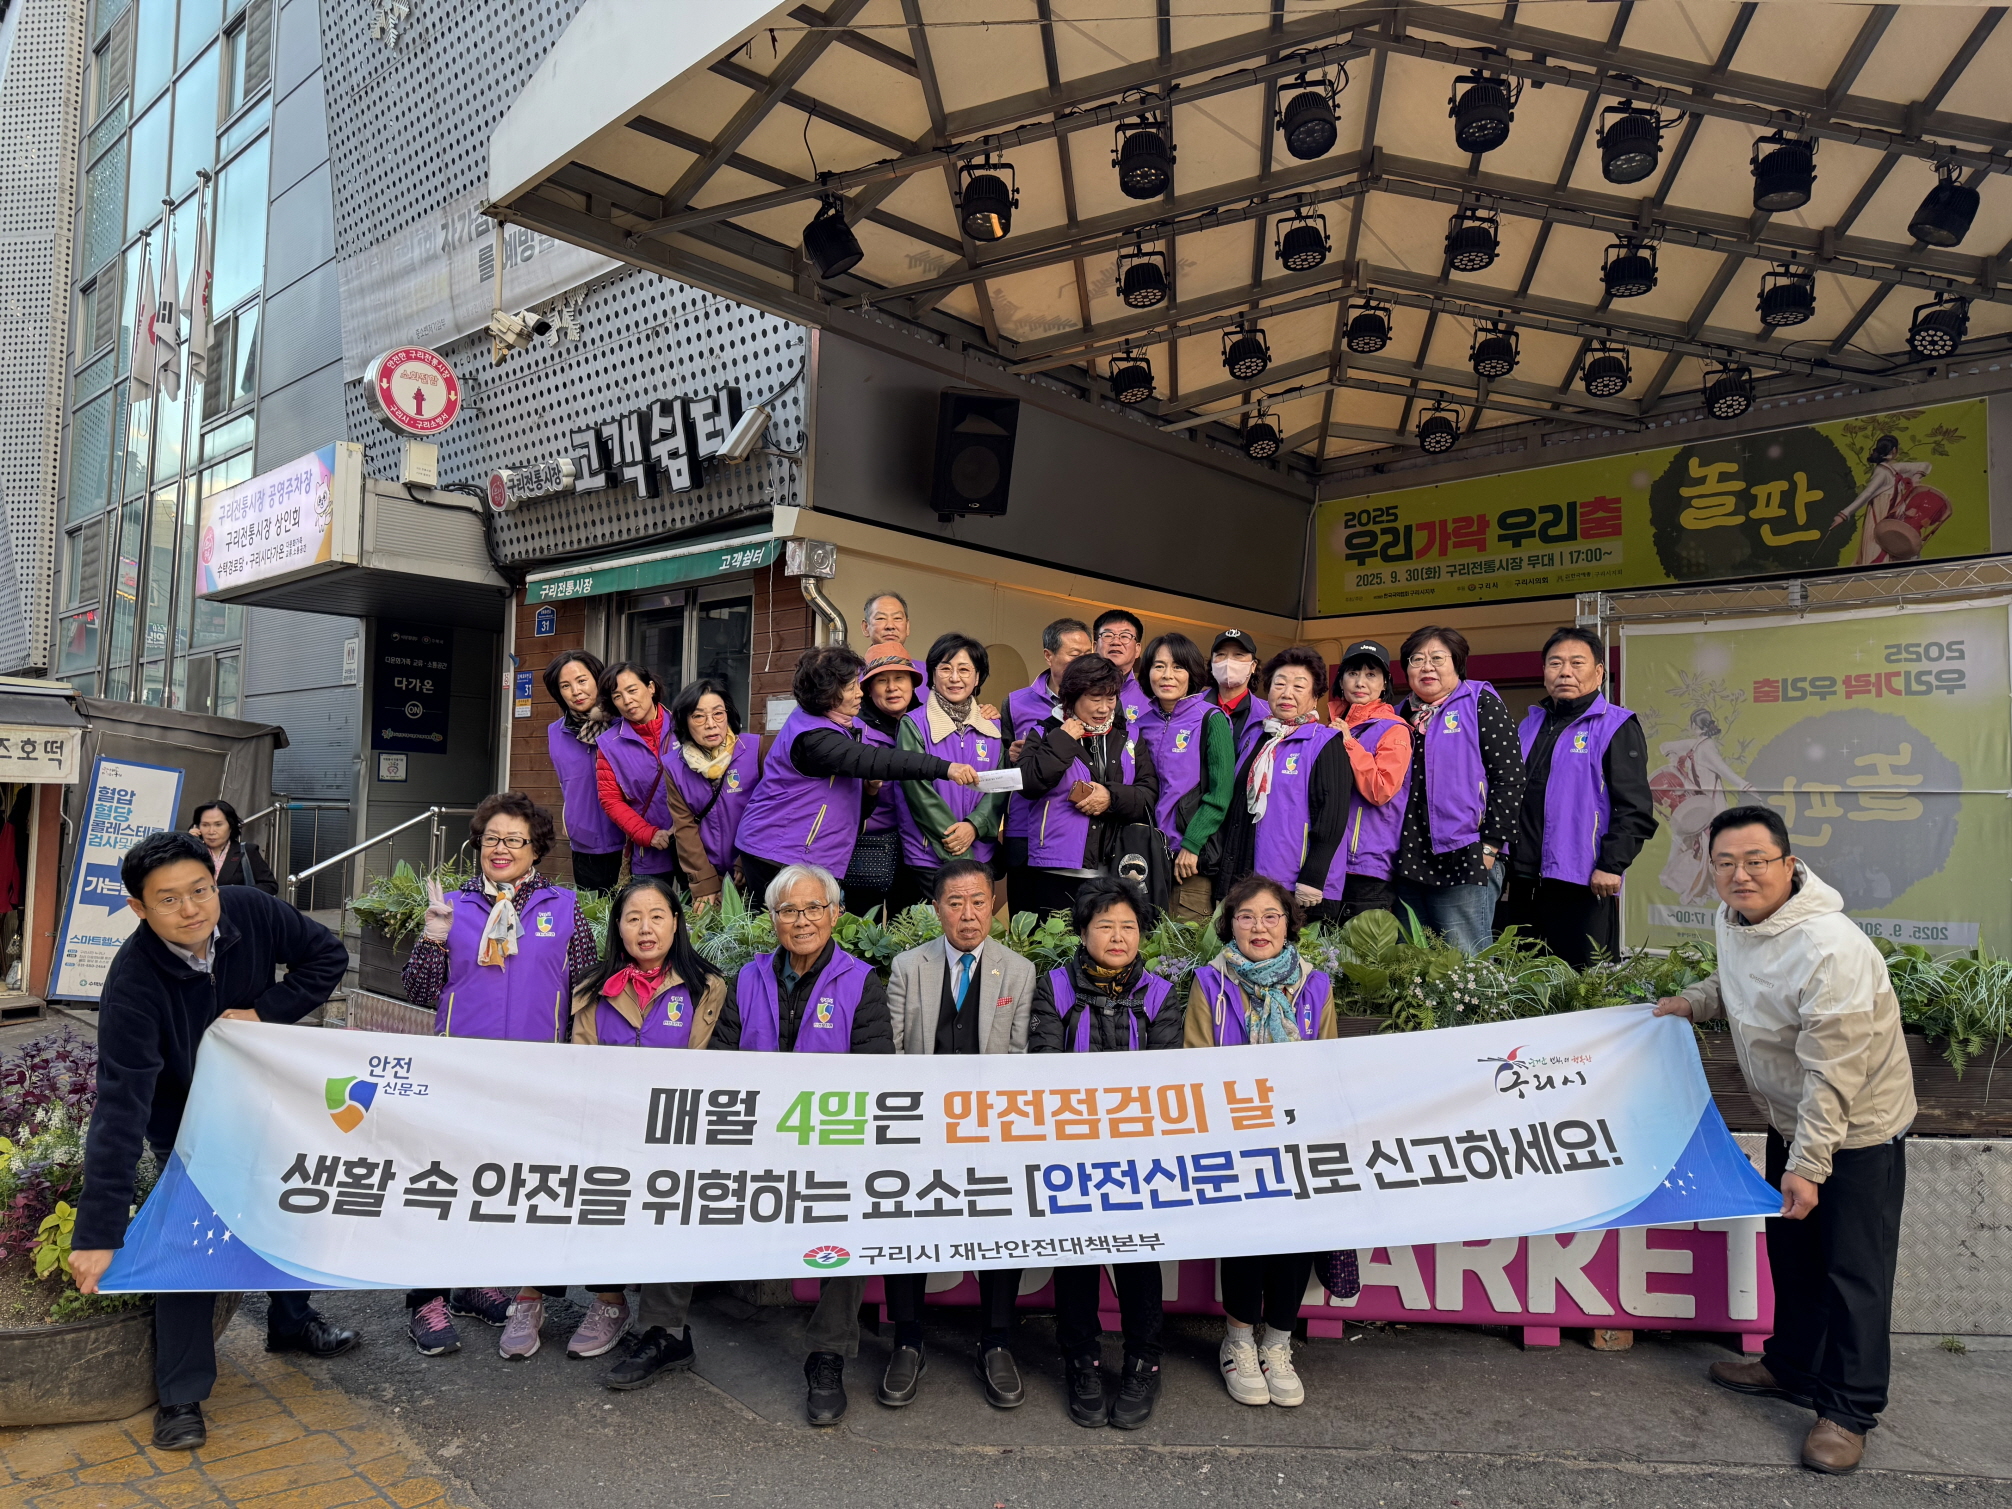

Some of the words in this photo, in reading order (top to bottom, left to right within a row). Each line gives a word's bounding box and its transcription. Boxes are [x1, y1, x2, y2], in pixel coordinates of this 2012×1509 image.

[400, 370, 439, 386] 소화전함
[409, 350, 451, 379] 구리전통시장
[389, 404, 410, 424] 구리시
[415, 412, 449, 429] 구리소방서
[571, 386, 734, 499] 고객쉼터
[507, 463, 561, 496] 구리전통시장
[218, 489, 266, 526] 구리전통시장
[268, 469, 313, 509] 공영주차장
[1678, 456, 1824, 547] 놀판
[225, 517, 272, 552] 구리전통시장
[274, 506, 301, 537] 상인회
[1344, 505, 1399, 529] 2025
[1344, 513, 1490, 566] 우리가락
[1497, 496, 1623, 548] 우리춤
[217, 556, 245, 579] 수택경로당
[539, 577, 593, 599] 구리전통시장
[719, 548, 766, 571] 고객쉼터
[1356, 572, 1386, 587] 2025.
[1390, 569, 1401, 584] 9.
[1405, 565, 1442, 582] 30(화)
[1446, 557, 1523, 578] 구리전통시장
[1527, 553, 1555, 569] 무대
[1569, 547, 1612, 564] 17:00~
[1478, 581, 1499, 591] 구리시
[1514, 576, 1549, 587] 구리시의회
[541, 620, 550, 632] 31
[394, 677, 434, 694] 다가온
[524, 684, 532, 696] 31
[408, 705, 420, 714] ON
[97, 786, 137, 806] 혈압
[91, 803, 134, 823] 혈당
[367, 1054, 413, 1081] 안전
[382, 1081, 430, 1098] 신문고
[1499, 1070, 1587, 1099] 구리시
[644, 1087, 761, 1147] 매월
[776, 1090, 924, 1146] 4일은
[943, 1083, 1209, 1144] 안전점검의
[1223, 1077, 1297, 1132] 날,
[278, 1152, 396, 1218] 생활
[402, 1160, 459, 1218] 속
[470, 1162, 632, 1226] 안전을
[641, 1167, 852, 1227] 위협하는
[862, 1167, 1014, 1221] 요소는
[1025, 1142, 1362, 1219] [안전신문고]로
[1365, 1118, 1625, 1191] 신고하세요!
[858, 1241, 941, 1266] 구리시
[948, 1233, 1166, 1262] 재난안전대책본부
[1300, 1217, 1767, 1321] ARKET
